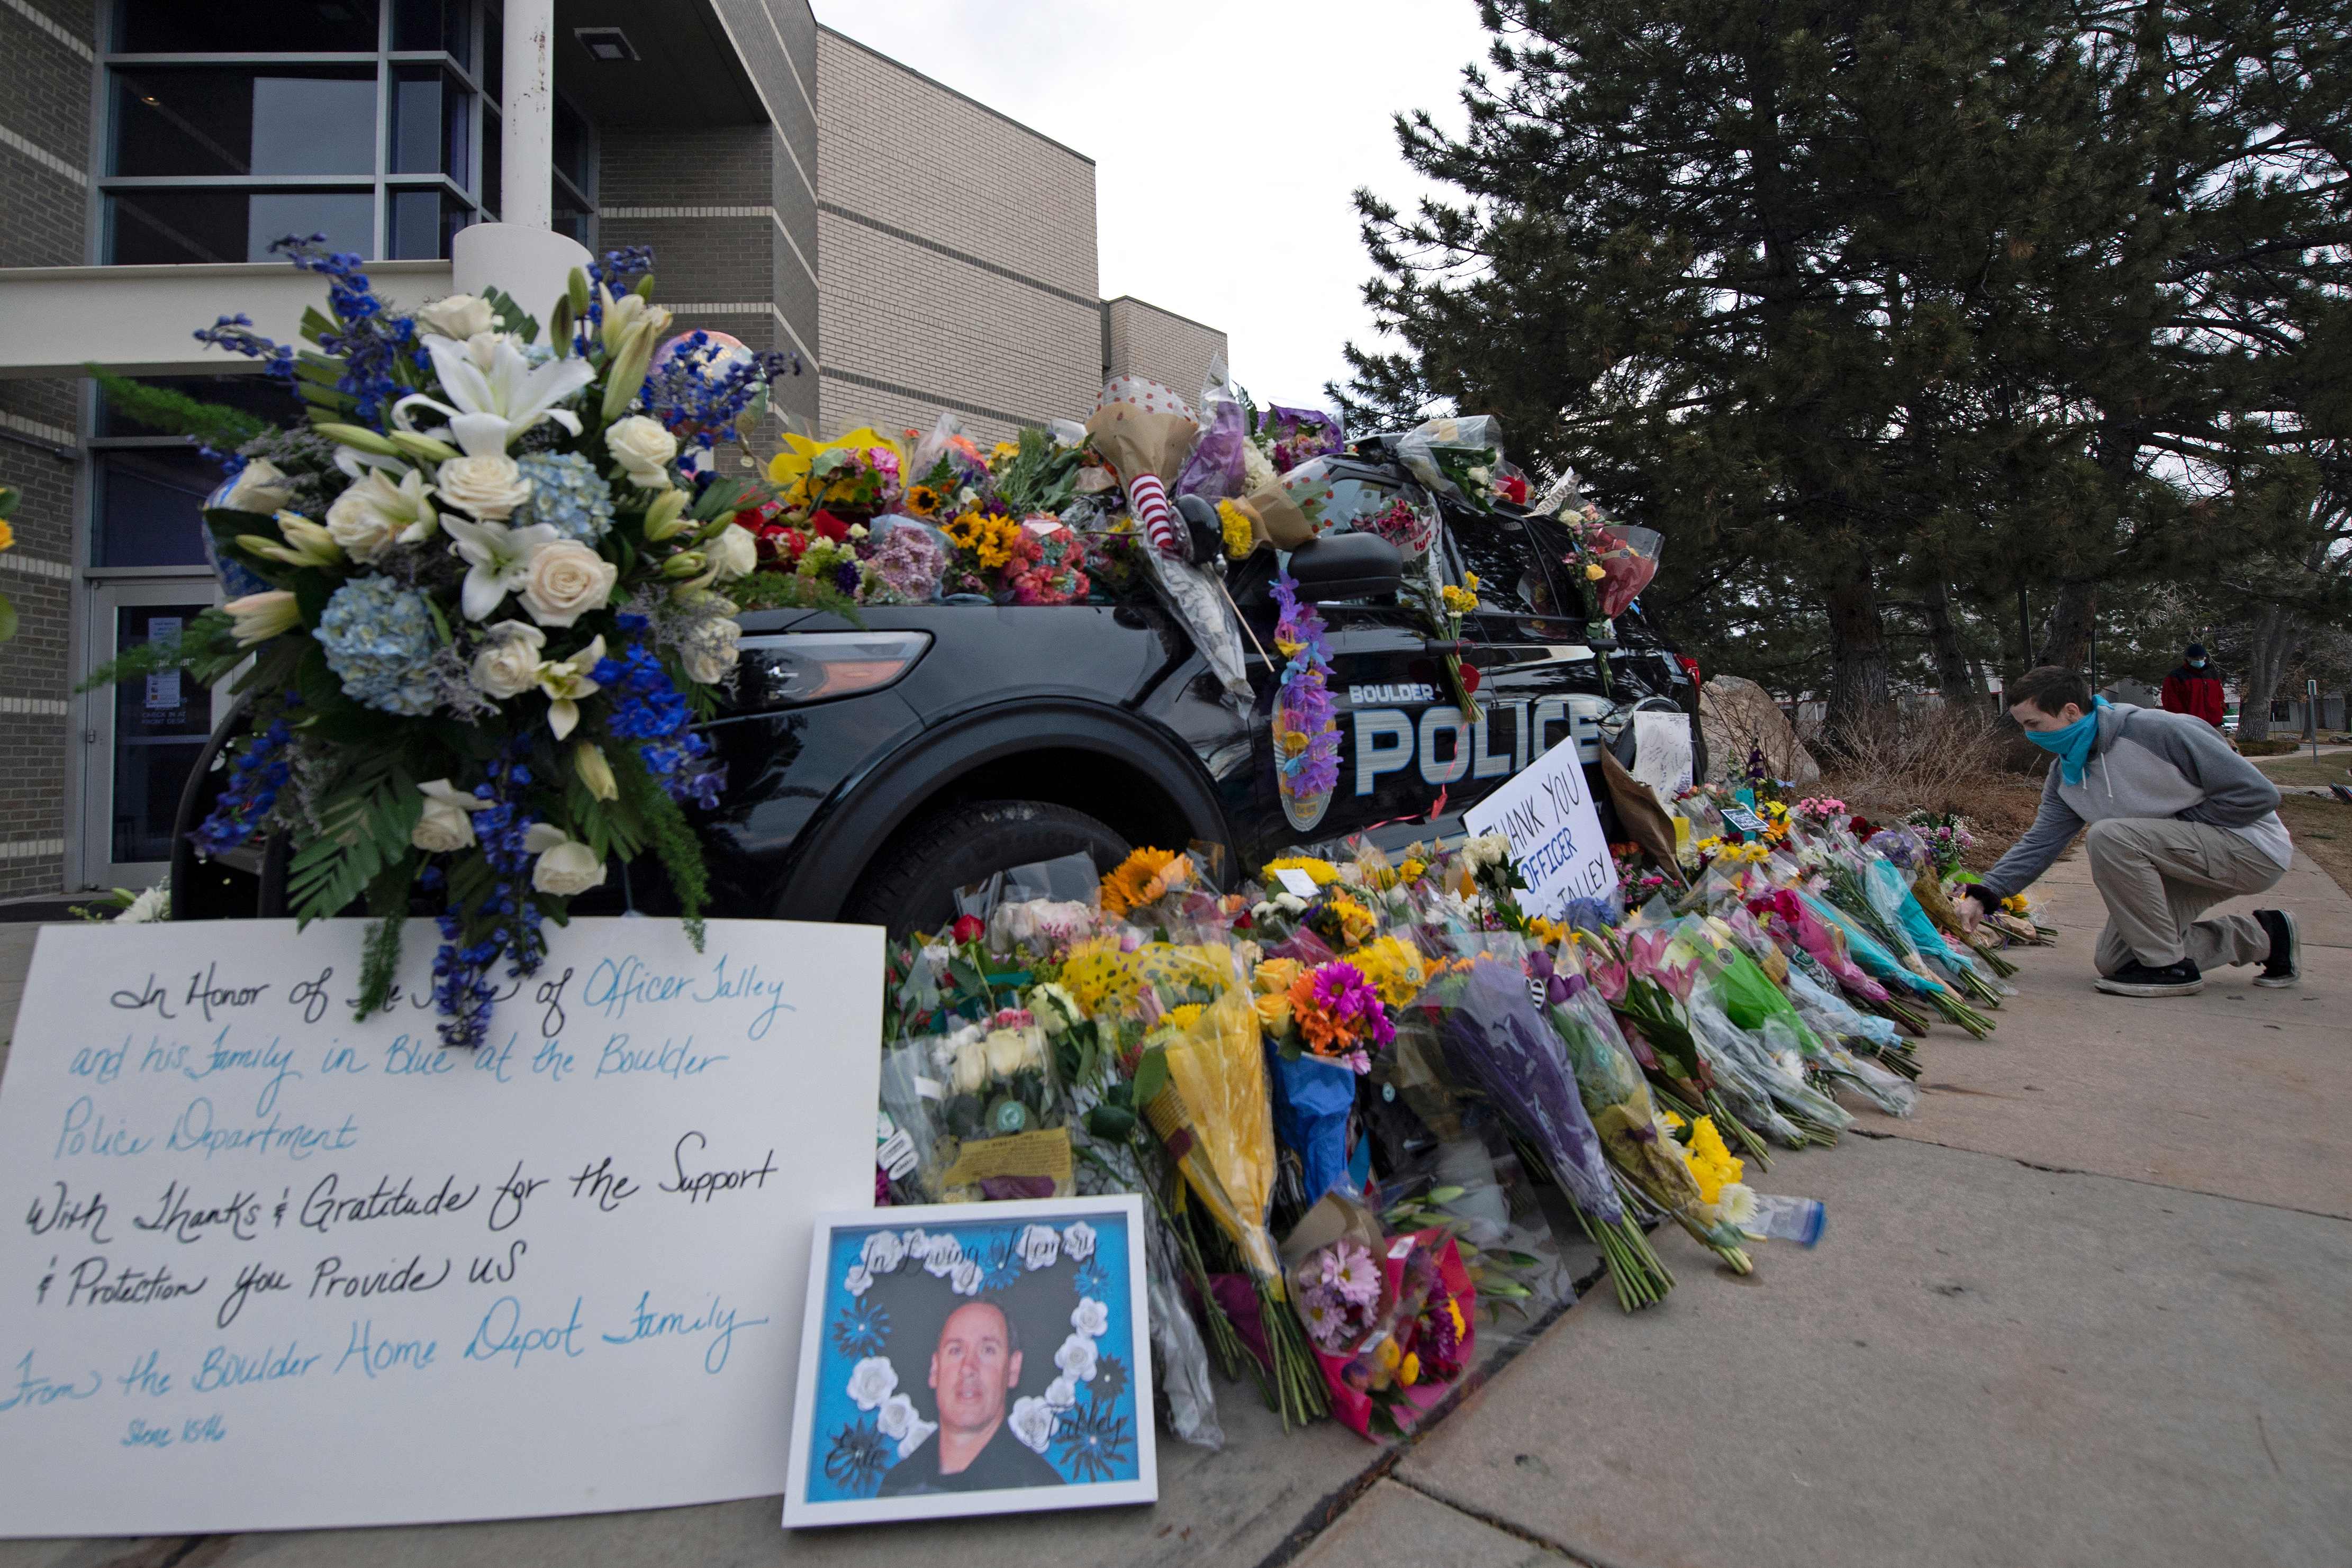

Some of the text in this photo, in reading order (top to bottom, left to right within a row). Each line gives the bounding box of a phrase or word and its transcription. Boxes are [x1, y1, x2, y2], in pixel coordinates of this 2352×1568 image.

[1349, 683, 1436, 703] BOULDER
[1353, 701, 1601, 796] POLICE
[1542, 762, 1579, 824] YOU
[1521, 827, 1578, 895] OFFICER
[185, 961, 270, 1022] Honor
[584, 955, 695, 1019] Officer
[693, 954, 797, 1040] Talley
[69, 1035, 132, 1083] and
[140, 1035, 186, 1073] his
[321, 1038, 369, 1074] in
[384, 1034, 454, 1075] Blue
[474, 1032, 517, 1083] at
[533, 1040, 574, 1082] the
[595, 1034, 729, 1080] Boulder
[55, 1096, 359, 1159] Police Department
[26, 1181, 112, 1244] With
[300, 1173, 479, 1232] Gratitude
[489, 1161, 550, 1231] for
[570, 1156, 640, 1211] the
[658, 1131, 779, 1203] Support
[67, 1257, 207, 1306] Protection
[217, 1262, 291, 1328] you
[310, 1255, 451, 1298] Provide
[0, 1349, 103, 1410] From
[117, 1349, 171, 1397] the
[192, 1342, 321, 1393] Boulder
[334, 1320, 437, 1379] Home
[464, 1295, 584, 1368] Depot
